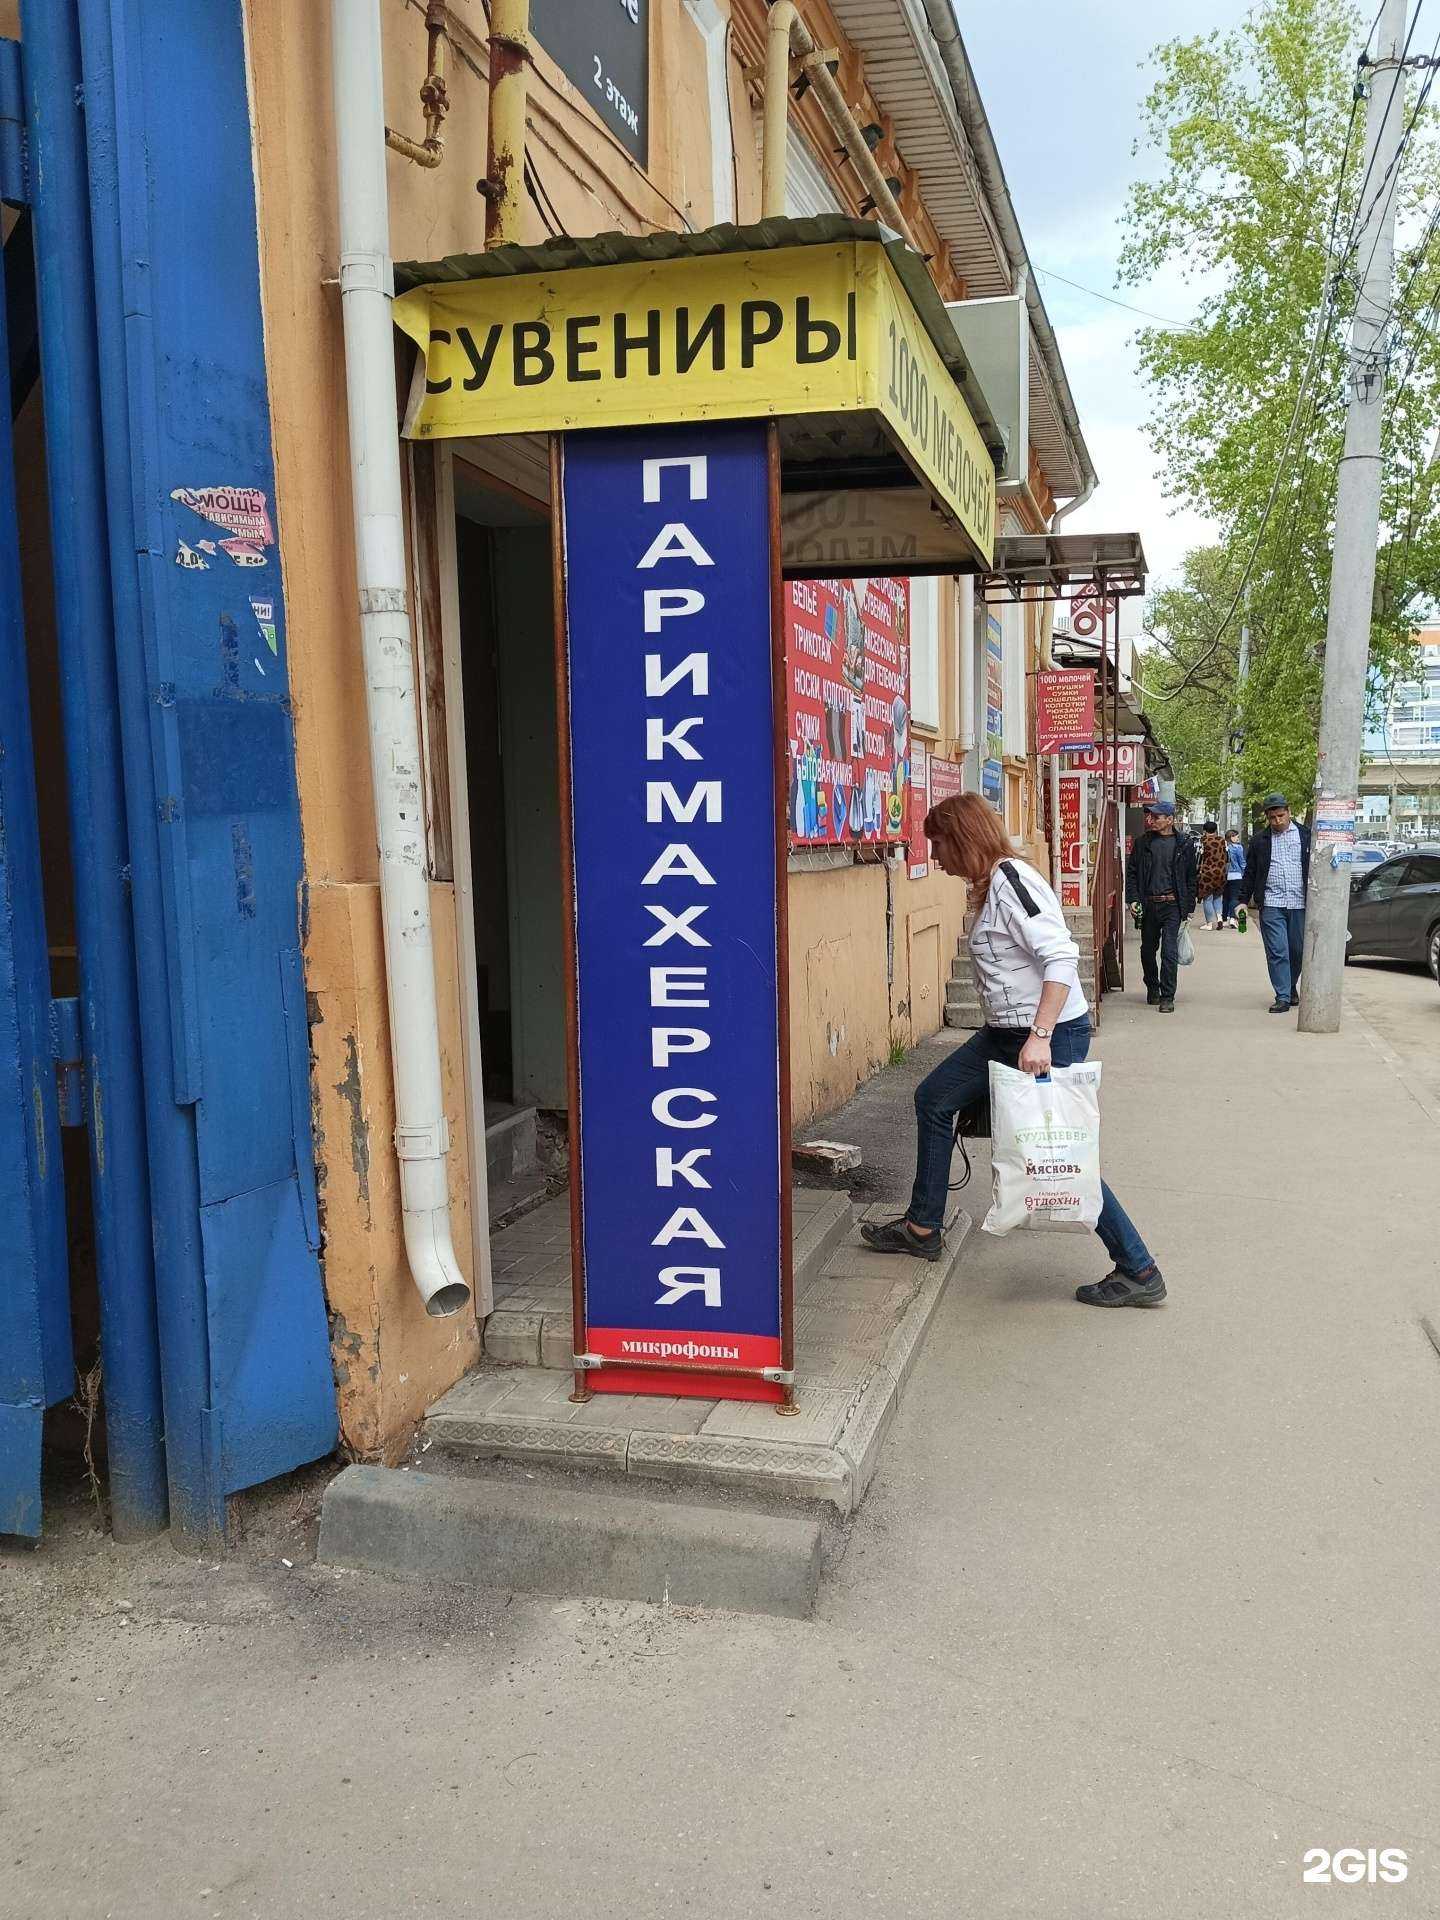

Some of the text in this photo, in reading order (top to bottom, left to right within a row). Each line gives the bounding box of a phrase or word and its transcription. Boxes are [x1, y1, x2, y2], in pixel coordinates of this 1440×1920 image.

[593, 54, 639, 136] 2 этаж
[425, 291, 857, 395] СУВЕНИРЫ
[888, 318, 992, 548] 1000 МЕЛОЧЕЙ
[792, 580, 818, 617] БЕЛЬЁ
[863, 590, 892, 628] СУВЕНИРЫ
[793, 622, 832, 665] ТРИКОТАЖ
[794, 666, 822, 704] НОСКИ,
[864, 656, 875, 684] ДЛЯ
[1040, 672, 1091, 684] 1000 мелочей
[1043, 695, 1088, 703] КОШЕЛЬКИ
[1045, 701, 1086, 709] КОЛГОТКИ
[795, 710, 820, 741] СУМКИ
[796, 754, 853, 786] БЫТОВАЯ ХИМИЯ
[636, 455, 726, 1307] ПАРИКМАХЕРСКАЯ
[1025, 1164, 1081, 1175] МЯСНОВЪ
[621, 1340, 740, 1360] микрофоны
